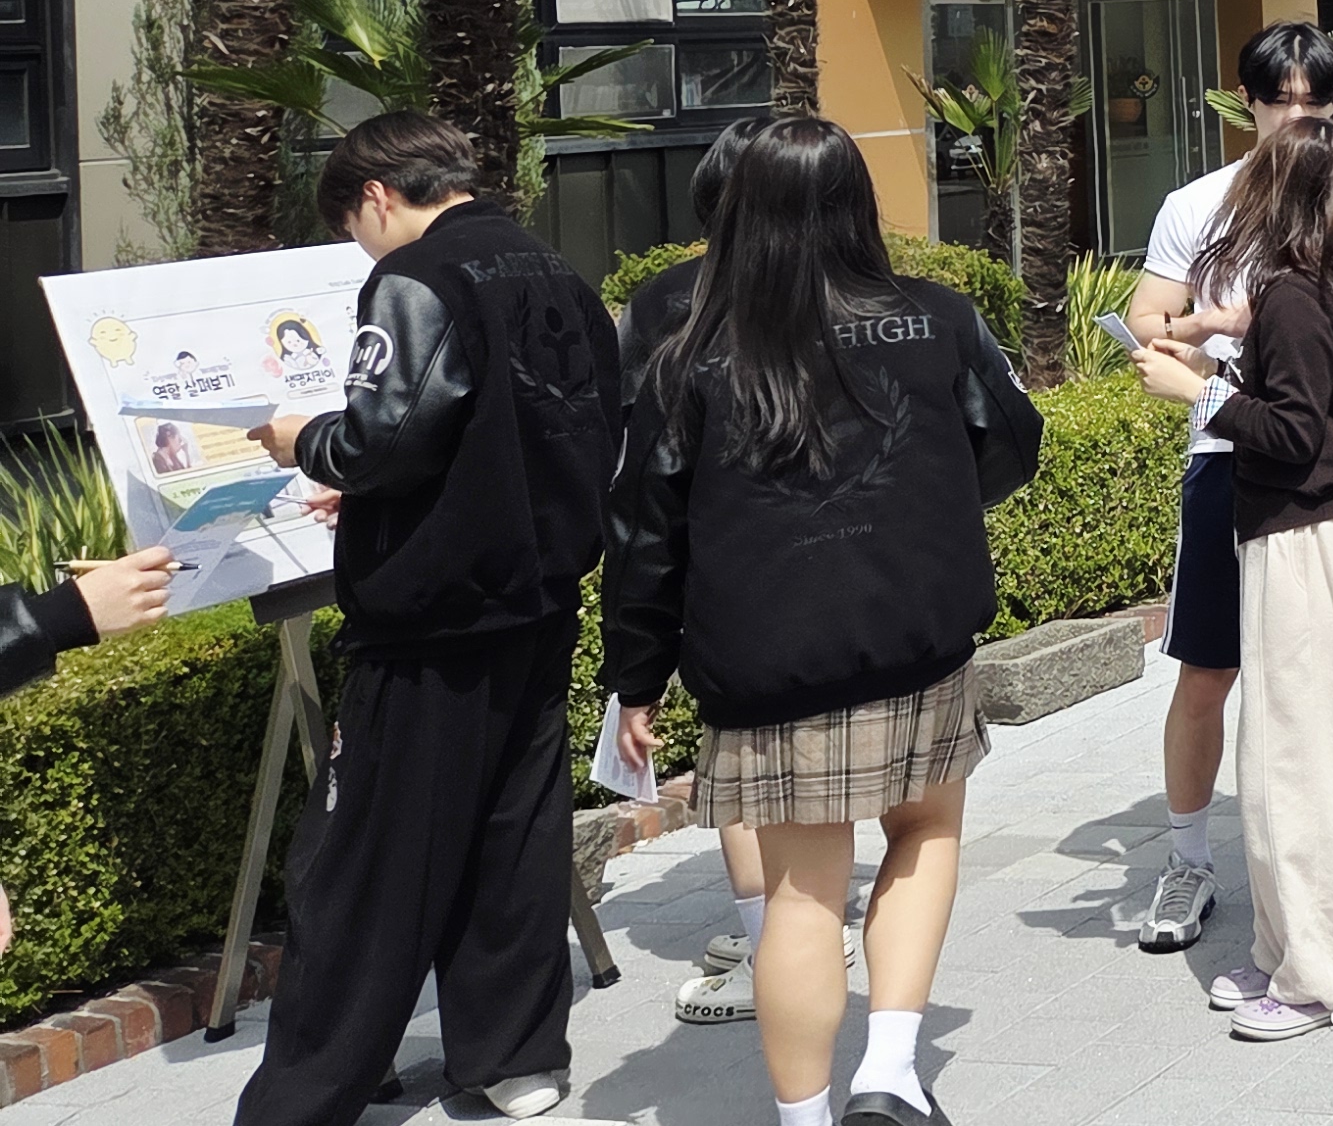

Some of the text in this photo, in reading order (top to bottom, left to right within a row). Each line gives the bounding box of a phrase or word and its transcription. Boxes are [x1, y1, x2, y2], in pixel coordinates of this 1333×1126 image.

[832, 314, 936, 349] HIGH
[152, 382, 181, 400] 역할
[184, 374, 236, 398] 살펴보기
[285, 368, 335, 388] 생명지킴이
[684, 1003, 735, 1017] crocs
